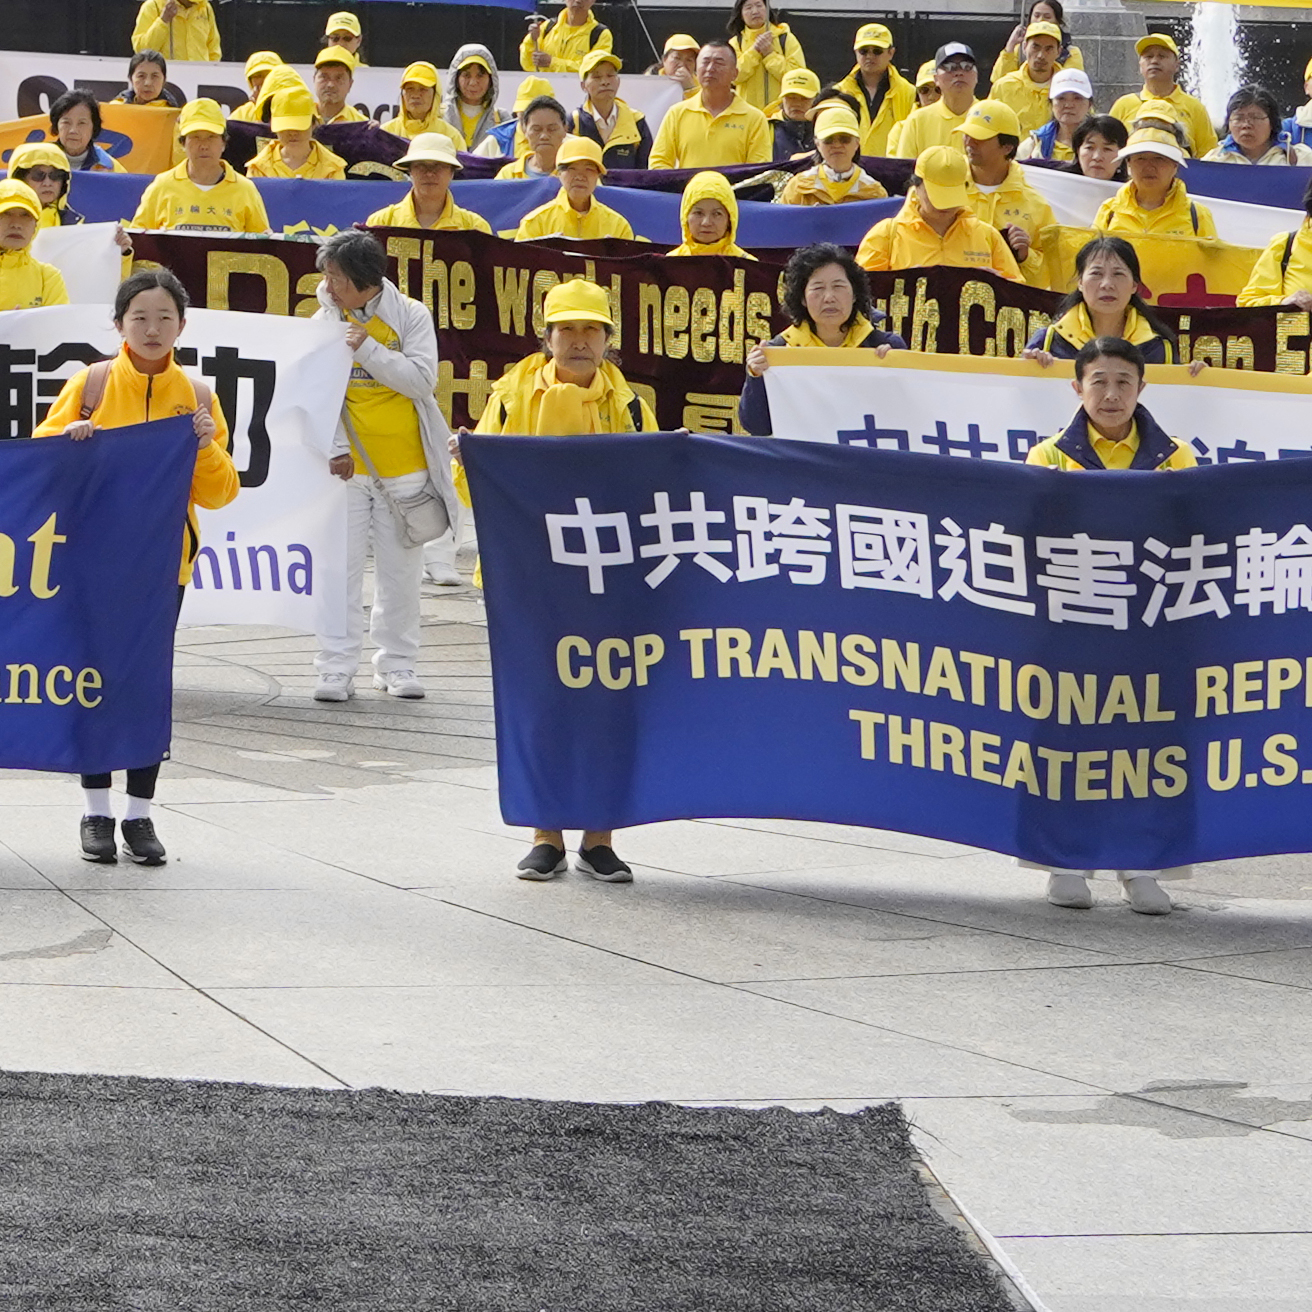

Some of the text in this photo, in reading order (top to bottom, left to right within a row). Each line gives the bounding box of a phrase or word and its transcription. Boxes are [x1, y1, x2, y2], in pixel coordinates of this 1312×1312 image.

[386, 236, 477, 332] The
[637, 267, 773, 364] needs
[555, 627, 1312, 725] CCP TRANSNATIONAL REP
[848, 709, 1312, 800] THREATENS U.S.
